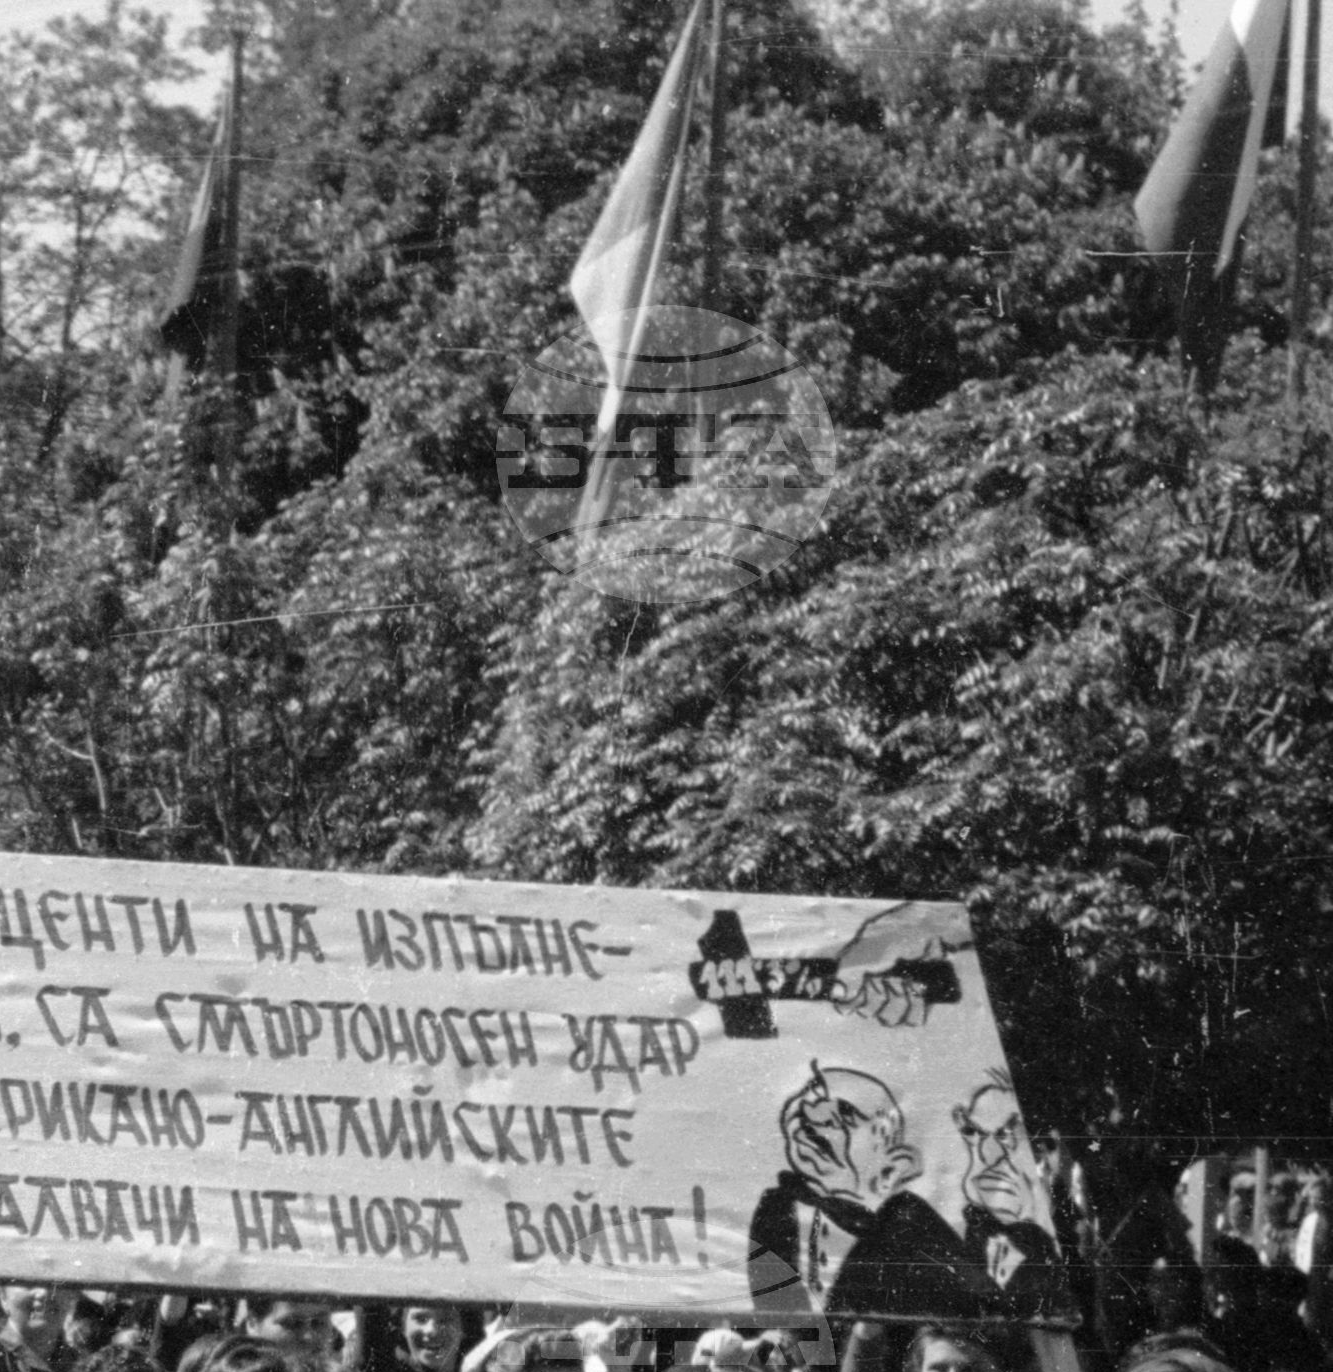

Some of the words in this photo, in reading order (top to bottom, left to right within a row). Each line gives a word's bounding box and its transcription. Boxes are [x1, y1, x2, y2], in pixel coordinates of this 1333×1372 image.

[243, 902, 325, 965] НА
[356, 906, 633, 982] ИЗПЪЛНЕ-
[35, 984, 120, 1048] СА
[154, 991, 539, 1071] СМЪРТОНОСЕН
[559, 1011, 701, 1095] УДАР
[232, 1188, 304, 1253] НА
[331, 1193, 471, 1263] НОВА
